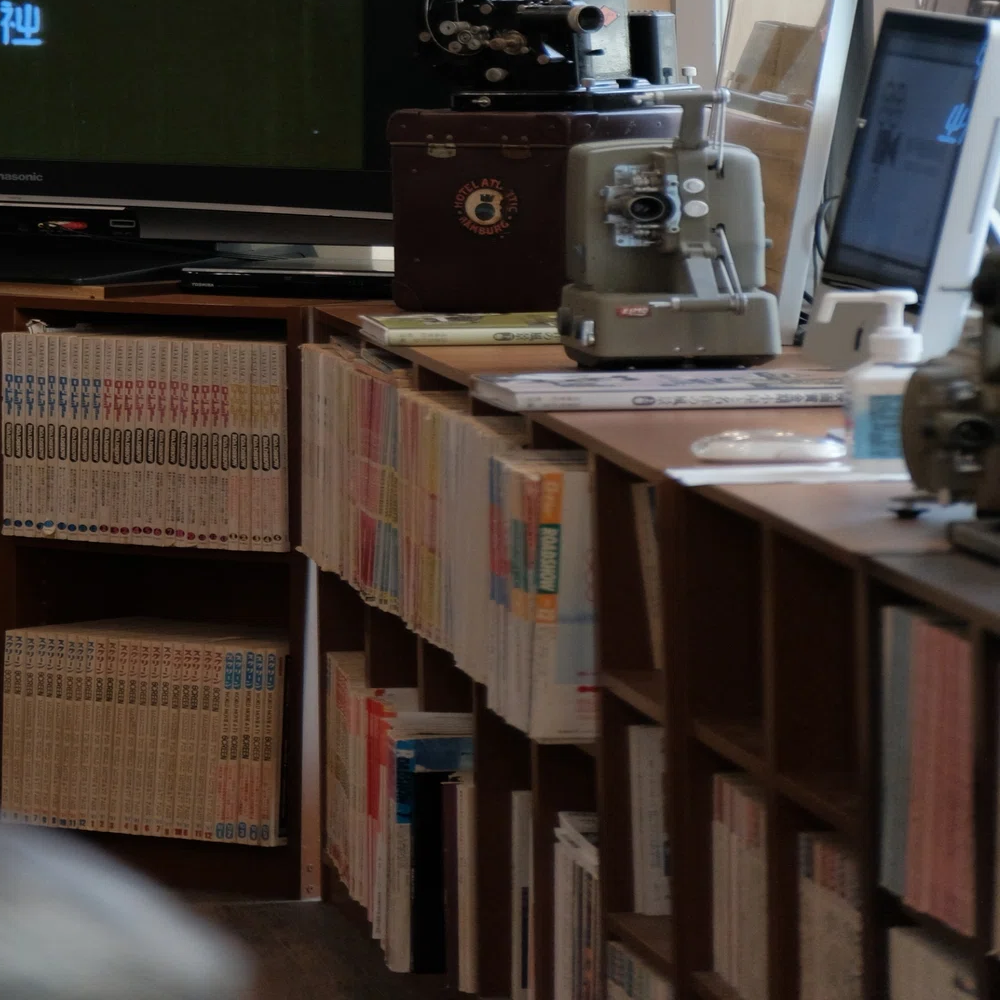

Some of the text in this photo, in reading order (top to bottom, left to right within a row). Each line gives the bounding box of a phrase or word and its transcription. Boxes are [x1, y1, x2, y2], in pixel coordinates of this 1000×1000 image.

[453, 178, 518, 213] HOTEL ATLTIC
[458, 215, 510, 236] HAMBURG
[540, 528, 559, 591] ROADSHOW
[5, 635, 13, 666] スクリーン
[14, 636, 22, 667] スクリーン
[26, 638, 34, 669] スクリーン
[37, 638, 46, 668] スクリーン
[47, 639, 55, 670] スクリーン
[56, 639, 64, 670] スクリーン
[67, 641, 75, 672] スクリーン
[96, 643, 105, 674] スクリーン
[106, 643, 116, 674] スクリーン
[119, 645, 128, 676] スクリーン
[129, 645, 138, 676] スクリーン
[140, 647, 148, 678] スクリーン
[151, 647, 160, 678] スクリーン
[163, 647, 171, 678] スクリーン
[173, 650, 181, 681] スクリーン
[183, 650, 192, 681] スクリーン
[191, 650, 200, 682] スクリーン
[204, 651, 212, 682] スクリーン
[213, 652, 222, 684] スクリーン
[225, 653, 234, 689] スクリーン
[234, 653, 242, 688] スクリーン
[245, 653, 254, 688] スクリーン
[267, 654, 275, 690] スクリーン
